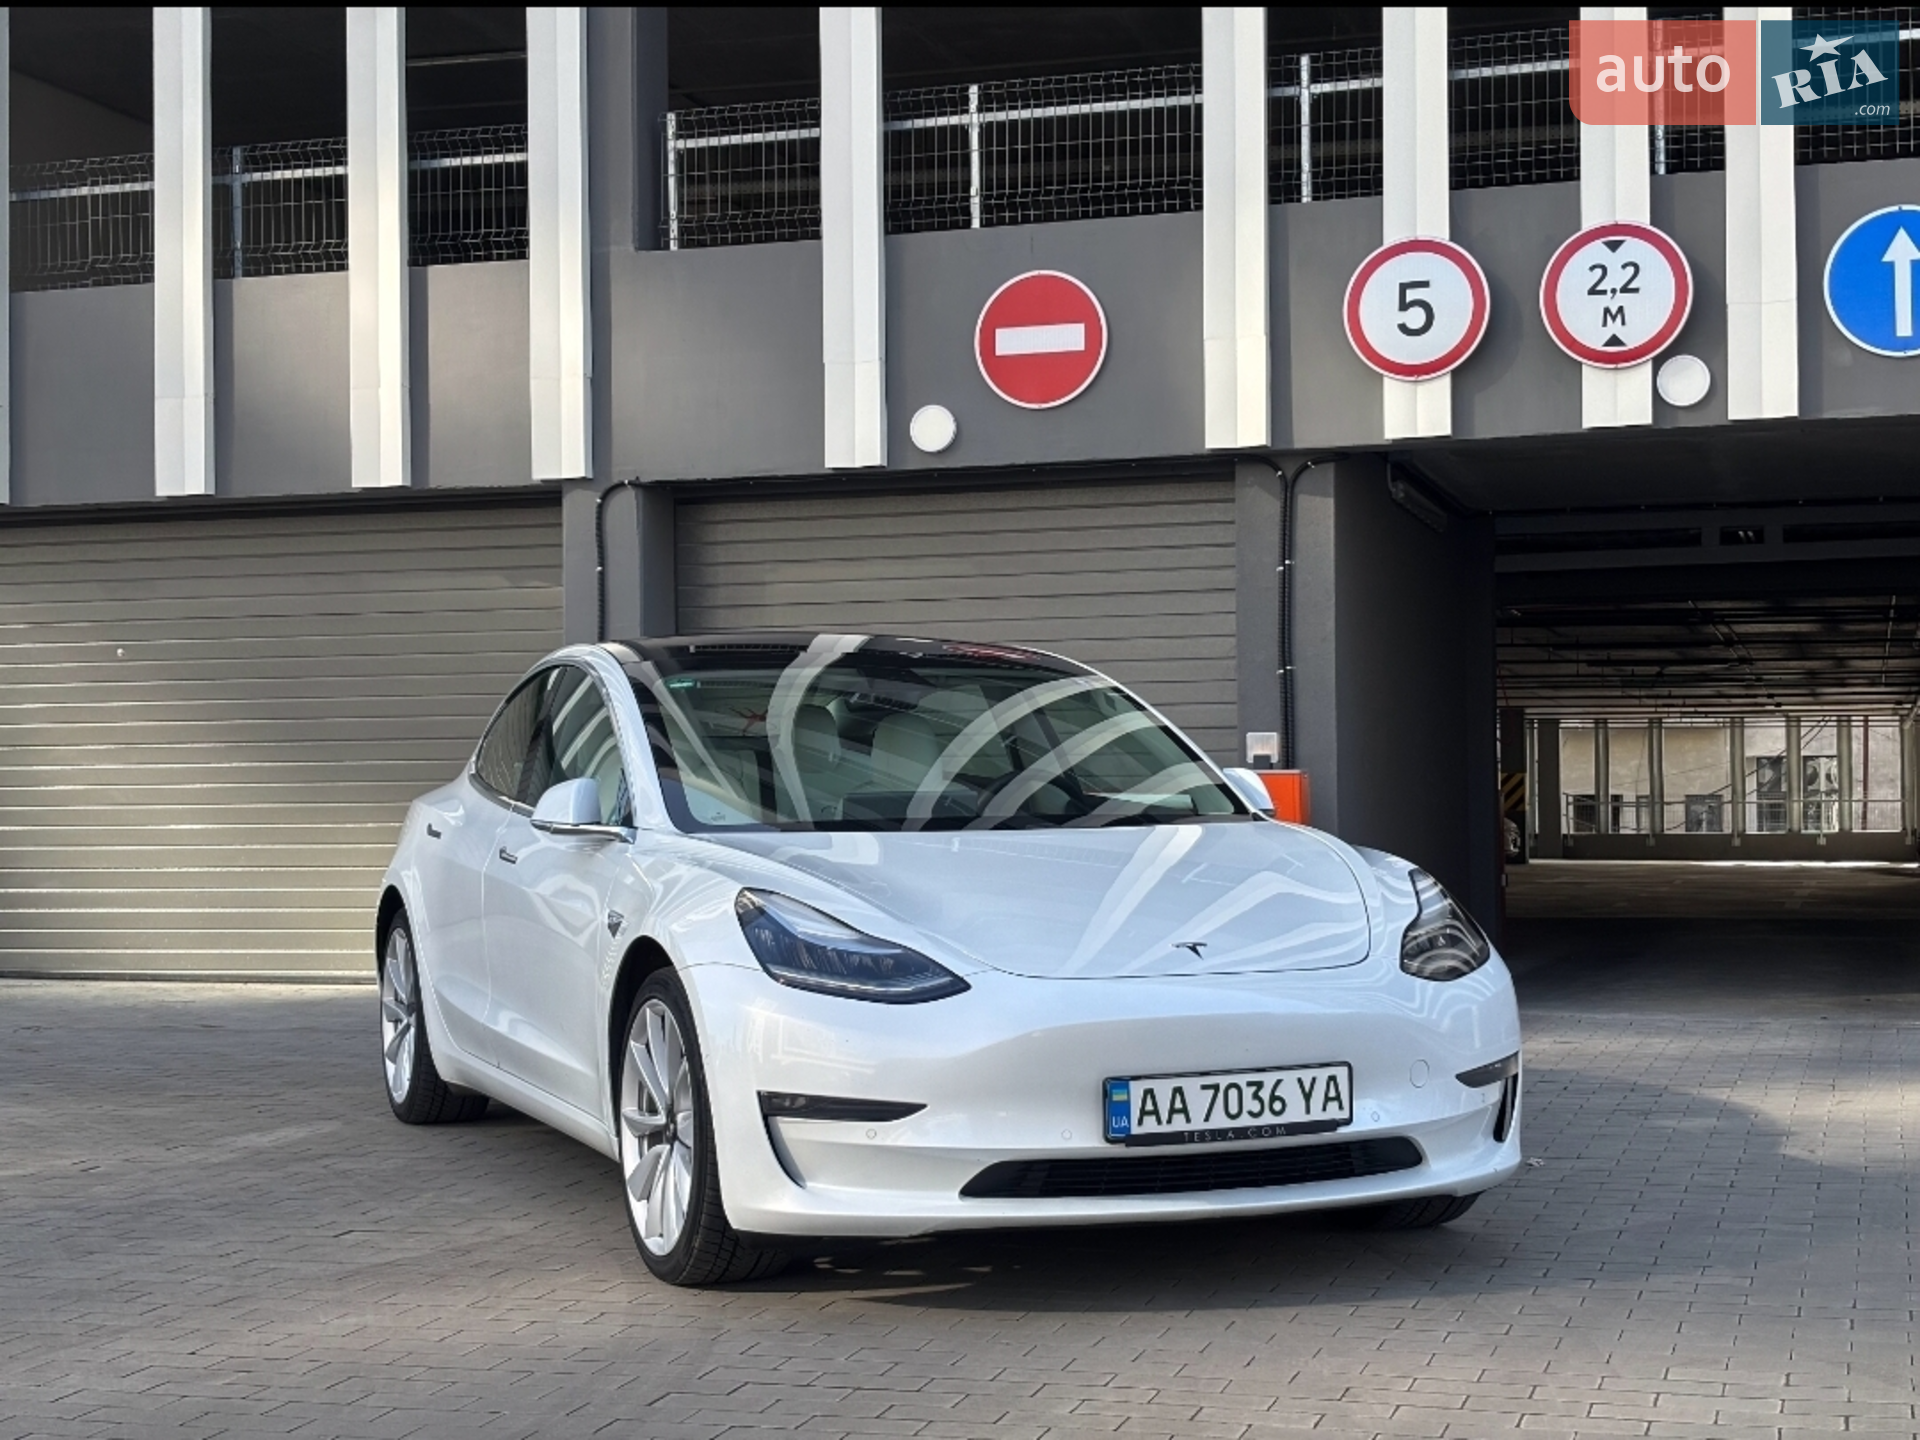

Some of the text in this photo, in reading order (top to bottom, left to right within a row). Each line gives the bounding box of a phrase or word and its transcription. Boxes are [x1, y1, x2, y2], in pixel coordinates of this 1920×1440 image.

[1587, 261, 1641, 299] 2,2
[1396, 280, 1435, 337] 5
[1137, 1074, 1344, 1127] AA 7036 YA
[1112, 1115, 1130, 1128] UA
[1183, 1126, 1287, 1142] TESLA.COM
